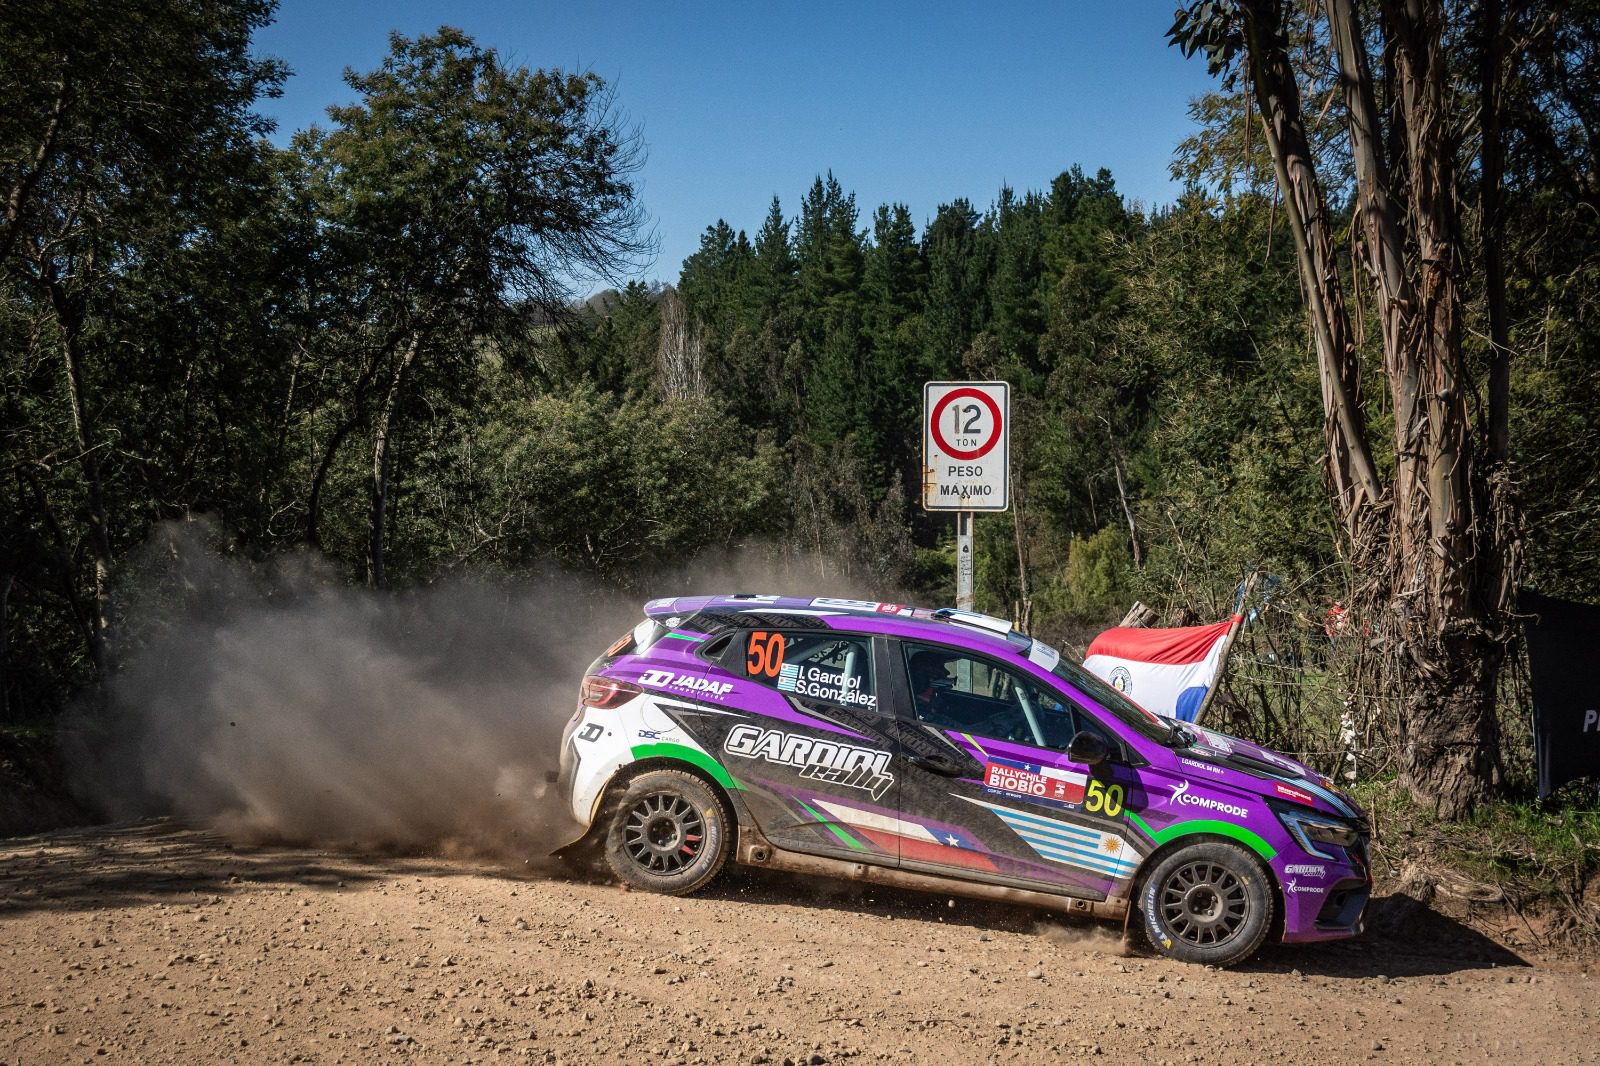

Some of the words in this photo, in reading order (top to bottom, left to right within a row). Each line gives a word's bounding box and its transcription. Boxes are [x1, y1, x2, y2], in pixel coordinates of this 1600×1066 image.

[951, 404, 982, 434] 12
[956, 438, 977, 447] TON
[948, 465, 983, 477] PESO
[747, 631, 785, 678] 50
[671, 674, 734, 696] JADAF
[807, 667, 861, 689] Gardiol
[1583, 709, 1600, 732] P
[638, 729, 661, 740] DSC
[661, 736, 681, 744] CARGO
[724, 724, 893, 779] GARDIOL
[991, 766, 1048, 784] RALLYCHILE
[1085, 779, 1124, 817] 50
[1182, 793, 1249, 818] COMPRODE
[1293, 885, 1324, 893] COMPRODE
